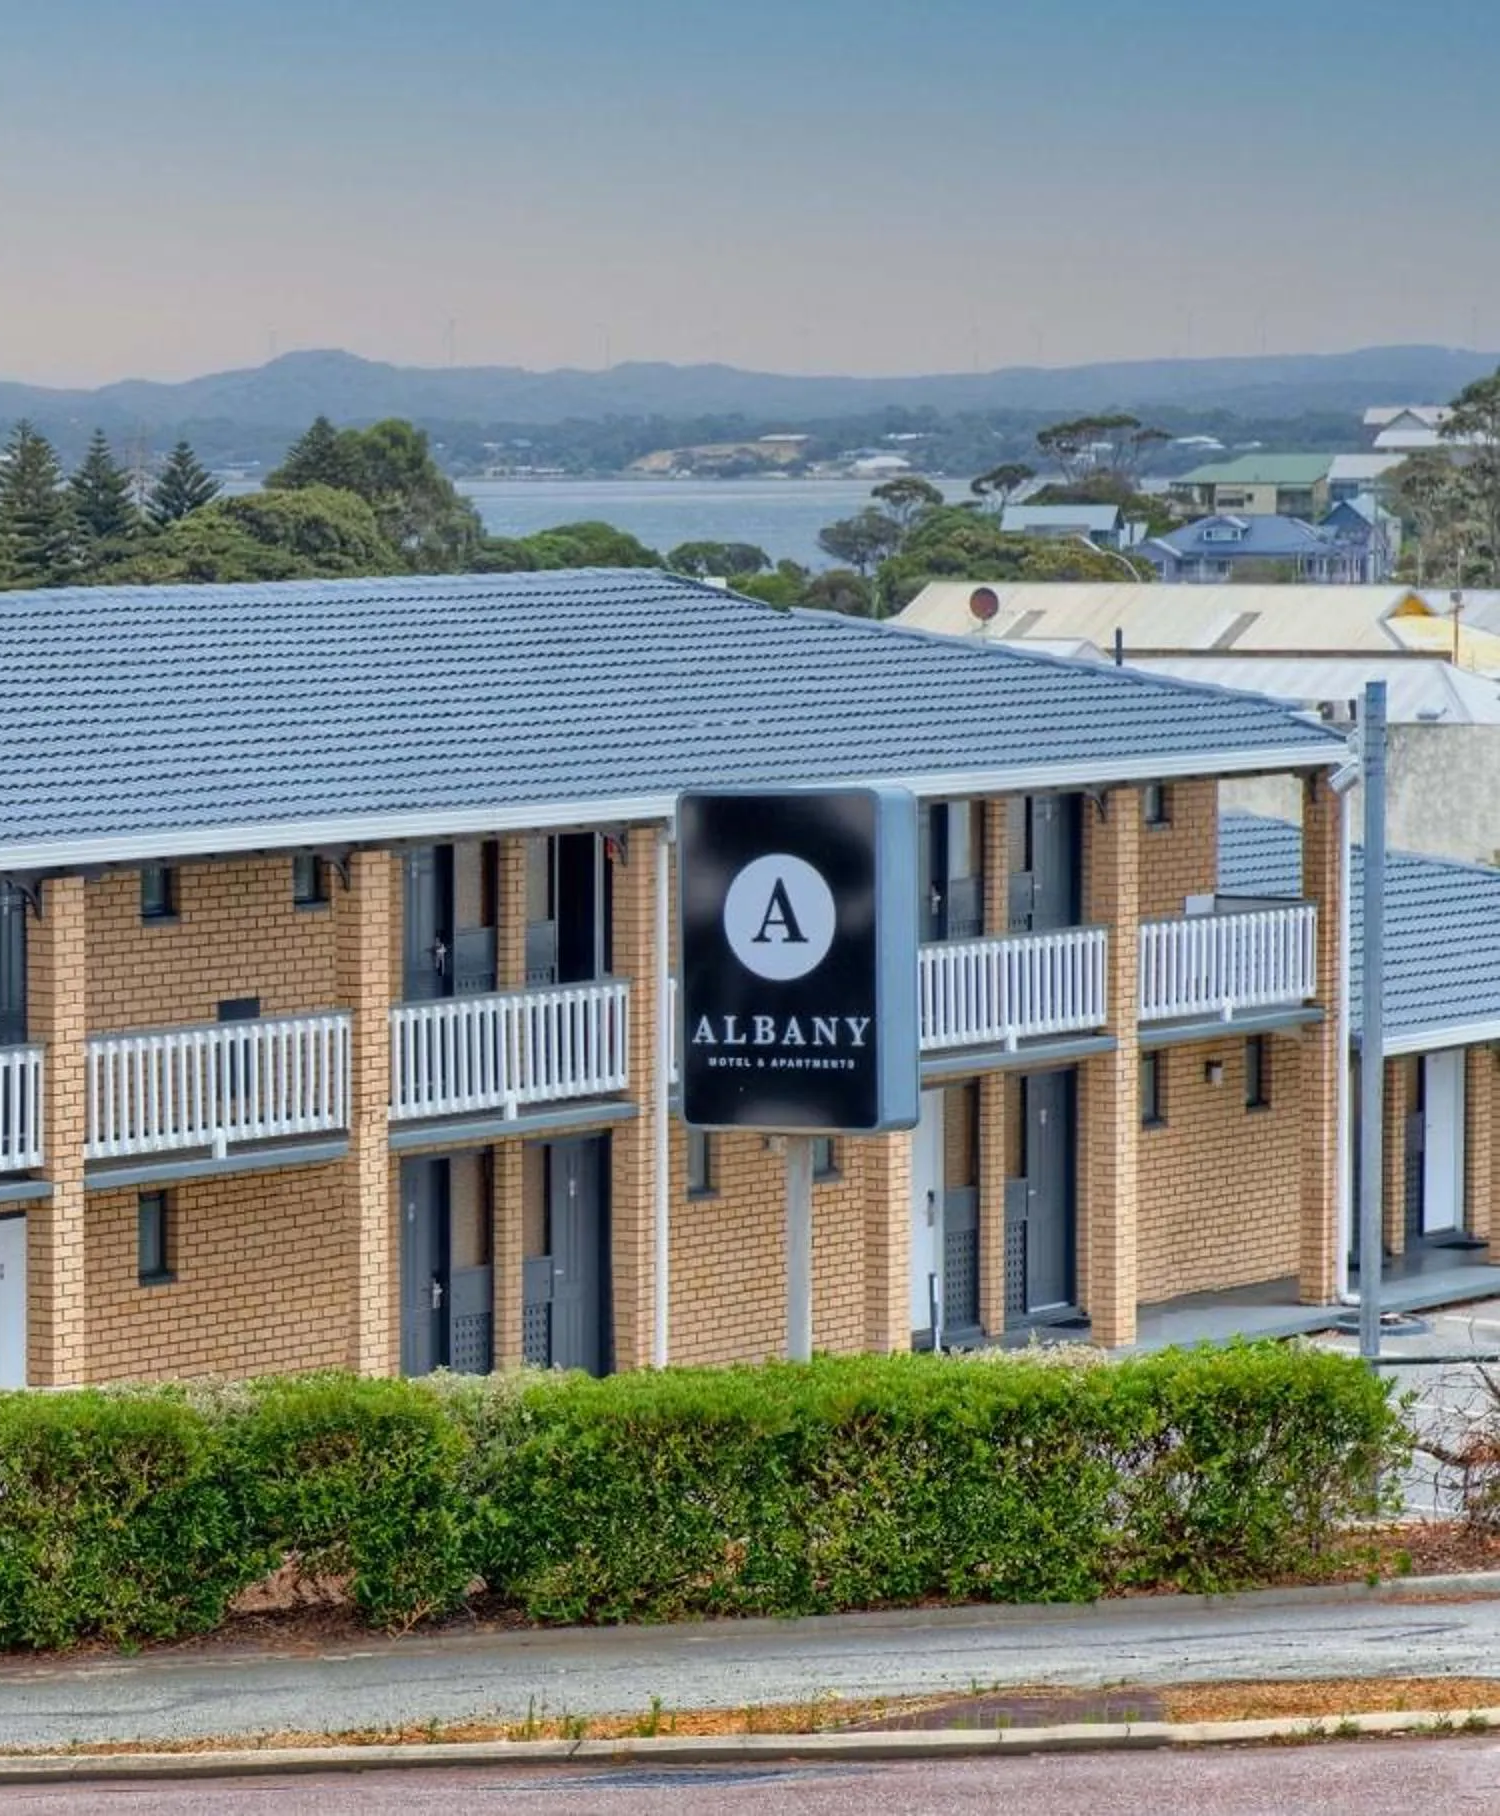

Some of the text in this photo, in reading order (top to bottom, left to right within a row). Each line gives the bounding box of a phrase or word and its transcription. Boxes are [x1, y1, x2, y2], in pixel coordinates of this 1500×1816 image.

[751, 877, 809, 943] A
[691, 1014, 871, 1046] ALBANY
[707, 1057, 751, 1068] MOTEL
[769, 1057, 856, 1070] APARTMENTS
